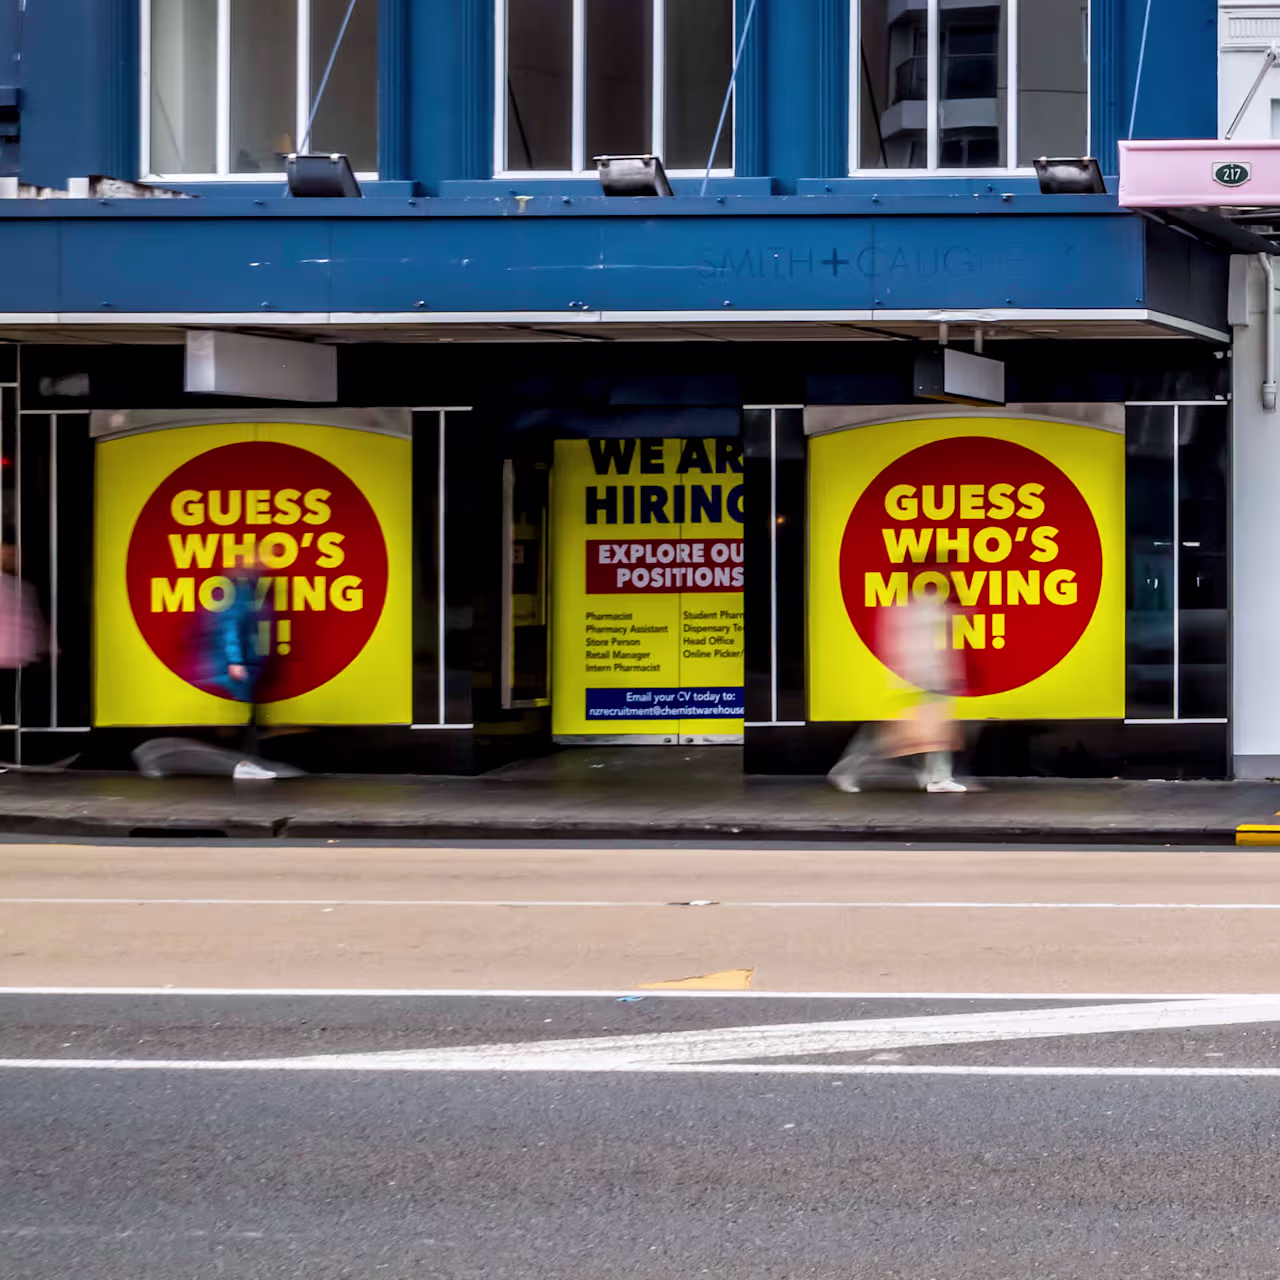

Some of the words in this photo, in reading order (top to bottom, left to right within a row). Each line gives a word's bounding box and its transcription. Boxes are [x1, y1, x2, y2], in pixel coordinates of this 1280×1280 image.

[1223, 168, 1241, 180] 217
[587, 438, 665, 475] WE
[675, 438, 744, 474] AR
[171, 488, 332, 526] GUESS
[884, 483, 1045, 521] GUESS
[168, 532, 346, 569] WHO'S
[882, 526, 1059, 563] WHO'S
[598, 543, 705, 564] EXPLORE
[710, 543, 744, 564] OU
[616, 566, 744, 588] POSITIONS
[864, 569, 1078, 607] MOVING
[585, 612, 633, 620] Pharmacist
[683, 610, 717, 619] Student
[585, 625, 628, 635] Pharmacy
[630, 624, 669, 633] Assistant
[683, 623, 730, 635] Dispensary
[732, 623, 744, 632] Te
[585, 637, 609, 646] Store
[611, 637, 641, 646] Person
[683, 636, 706, 645] Head
[708, 636, 735, 645] Office
[585, 650, 610, 659] Retail
[612, 651, 651, 661] Manager
[683, 649, 711, 658] Online
[585, 663, 612, 672] Intern
[613, 663, 661, 672] Pharmacist
[626, 691, 652, 702] Email
[653, 693, 675, 704] your
[677, 691, 691, 702] CV
[693, 690, 721, 703] today
[722, 692, 736, 701] to:
